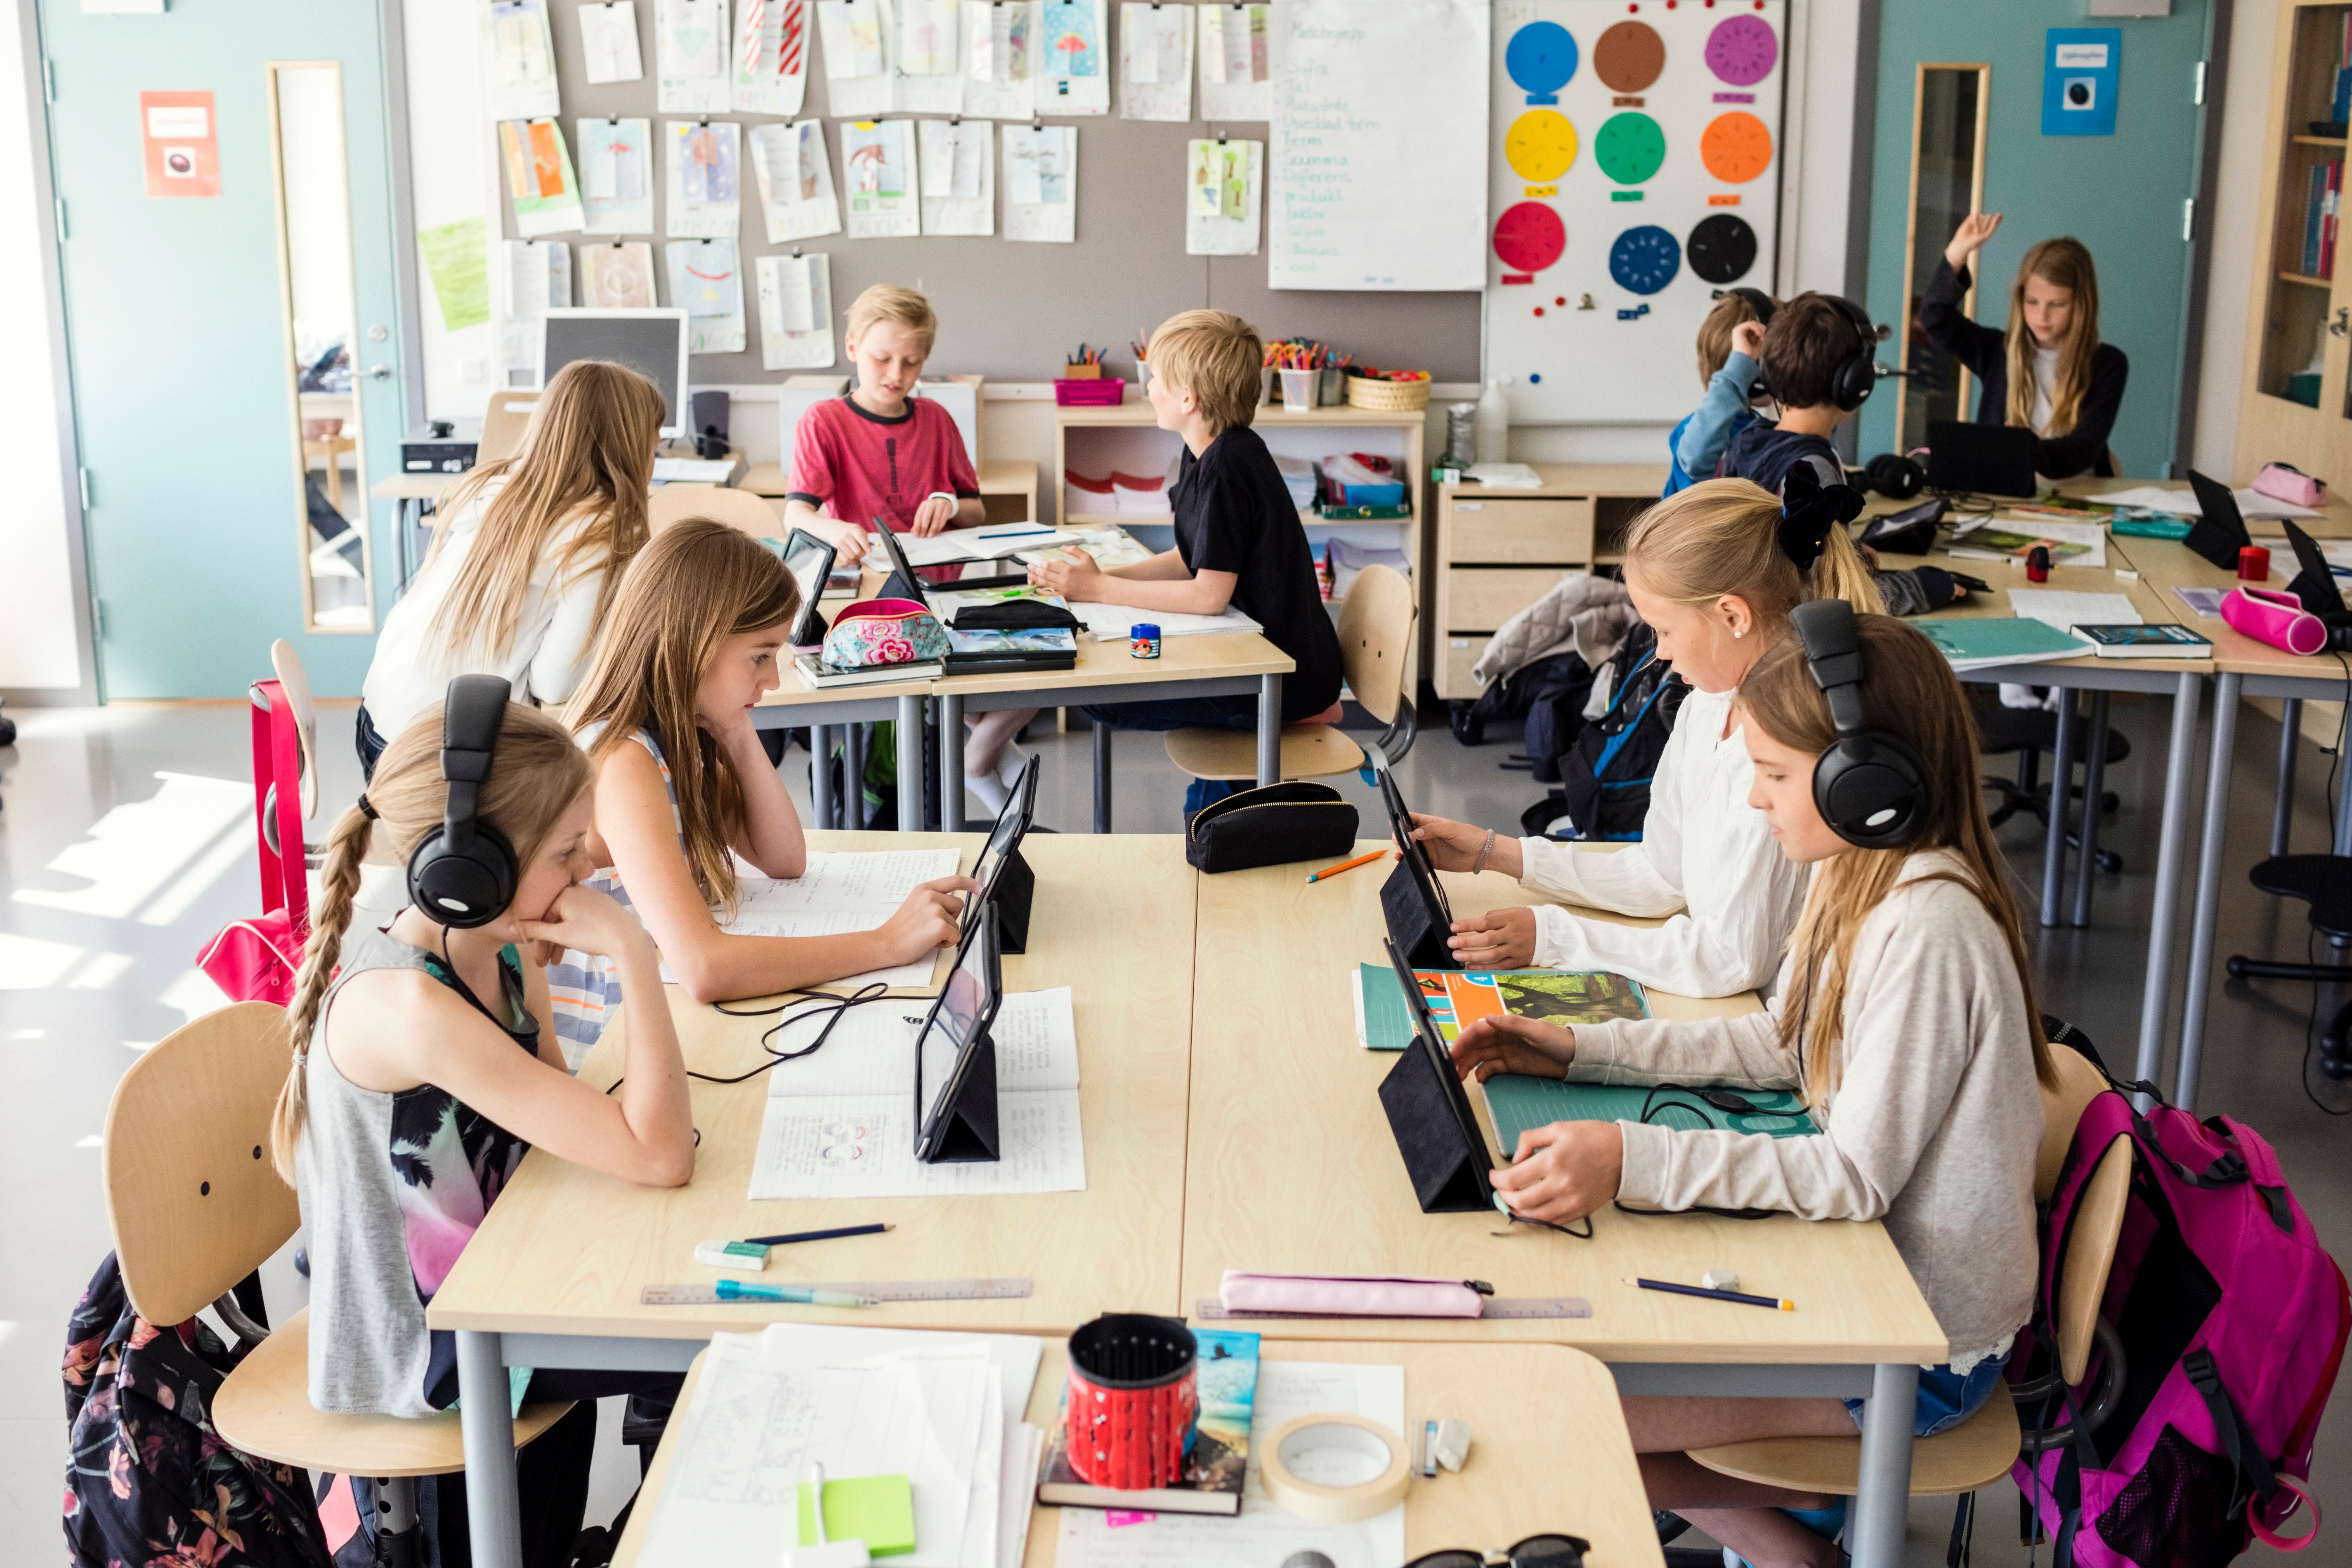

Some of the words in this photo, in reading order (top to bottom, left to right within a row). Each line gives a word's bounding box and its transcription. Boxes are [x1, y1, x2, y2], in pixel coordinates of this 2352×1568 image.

[1285, 57, 1329, 78] Siffra
[1282, 130, 1323, 147] Term
[1283, 149, 1350, 166] Summa
[1283, 168, 1353, 189] Differens
[1285, 188, 1344, 208] produkt
